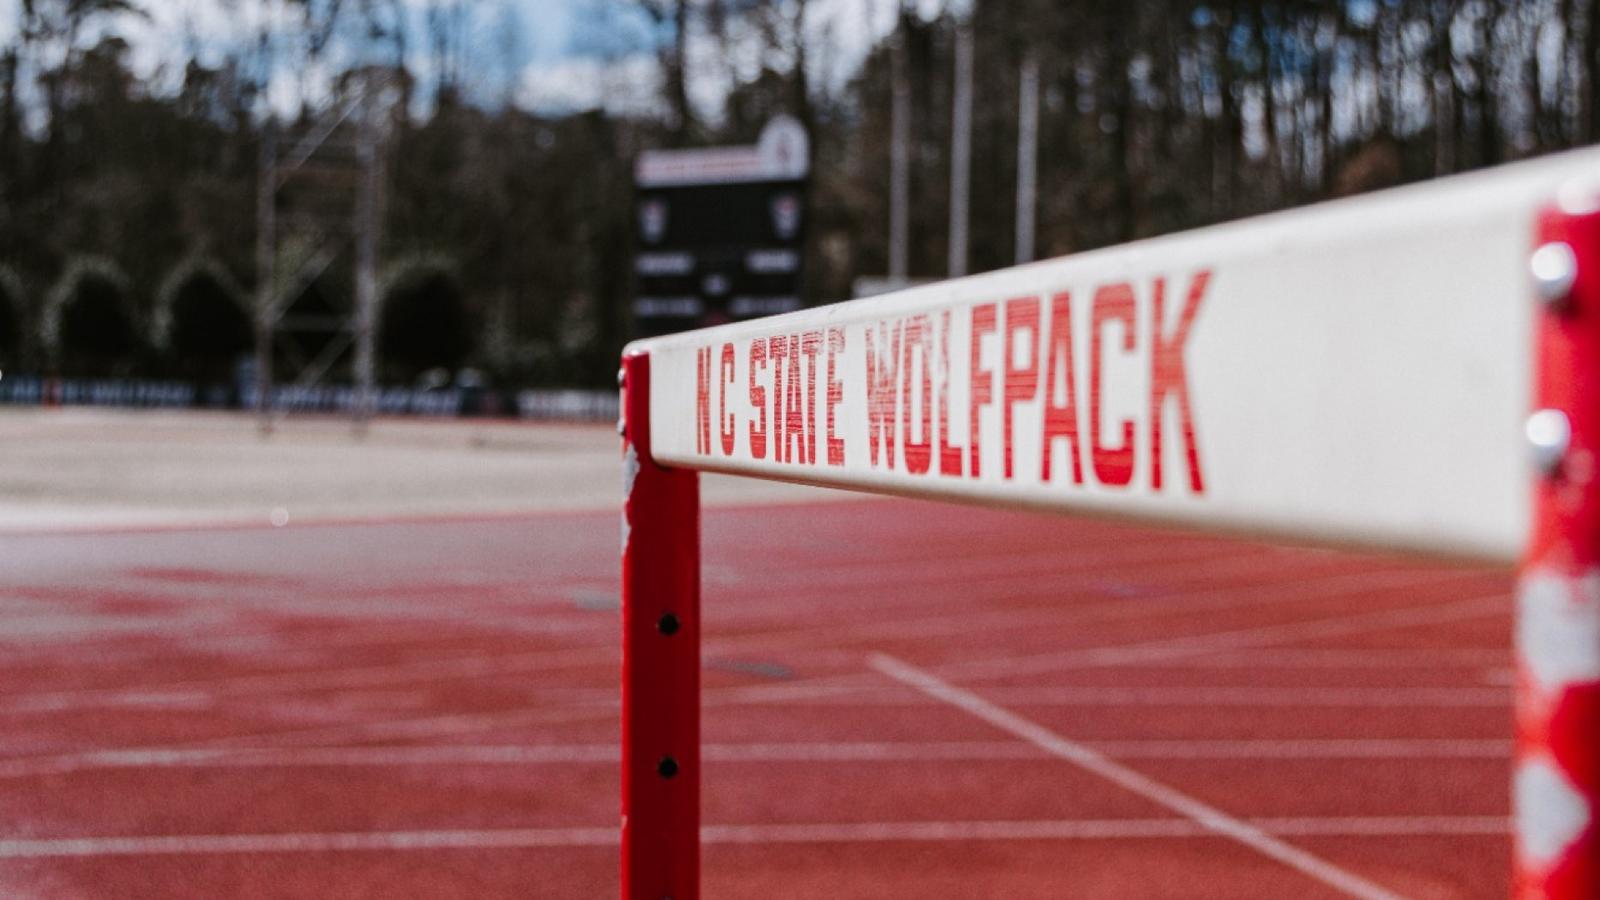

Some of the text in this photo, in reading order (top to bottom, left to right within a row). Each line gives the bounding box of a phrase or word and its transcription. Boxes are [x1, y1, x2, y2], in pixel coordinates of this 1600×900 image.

[696, 270, 1212, 493] N C STATE WOLFPACK
